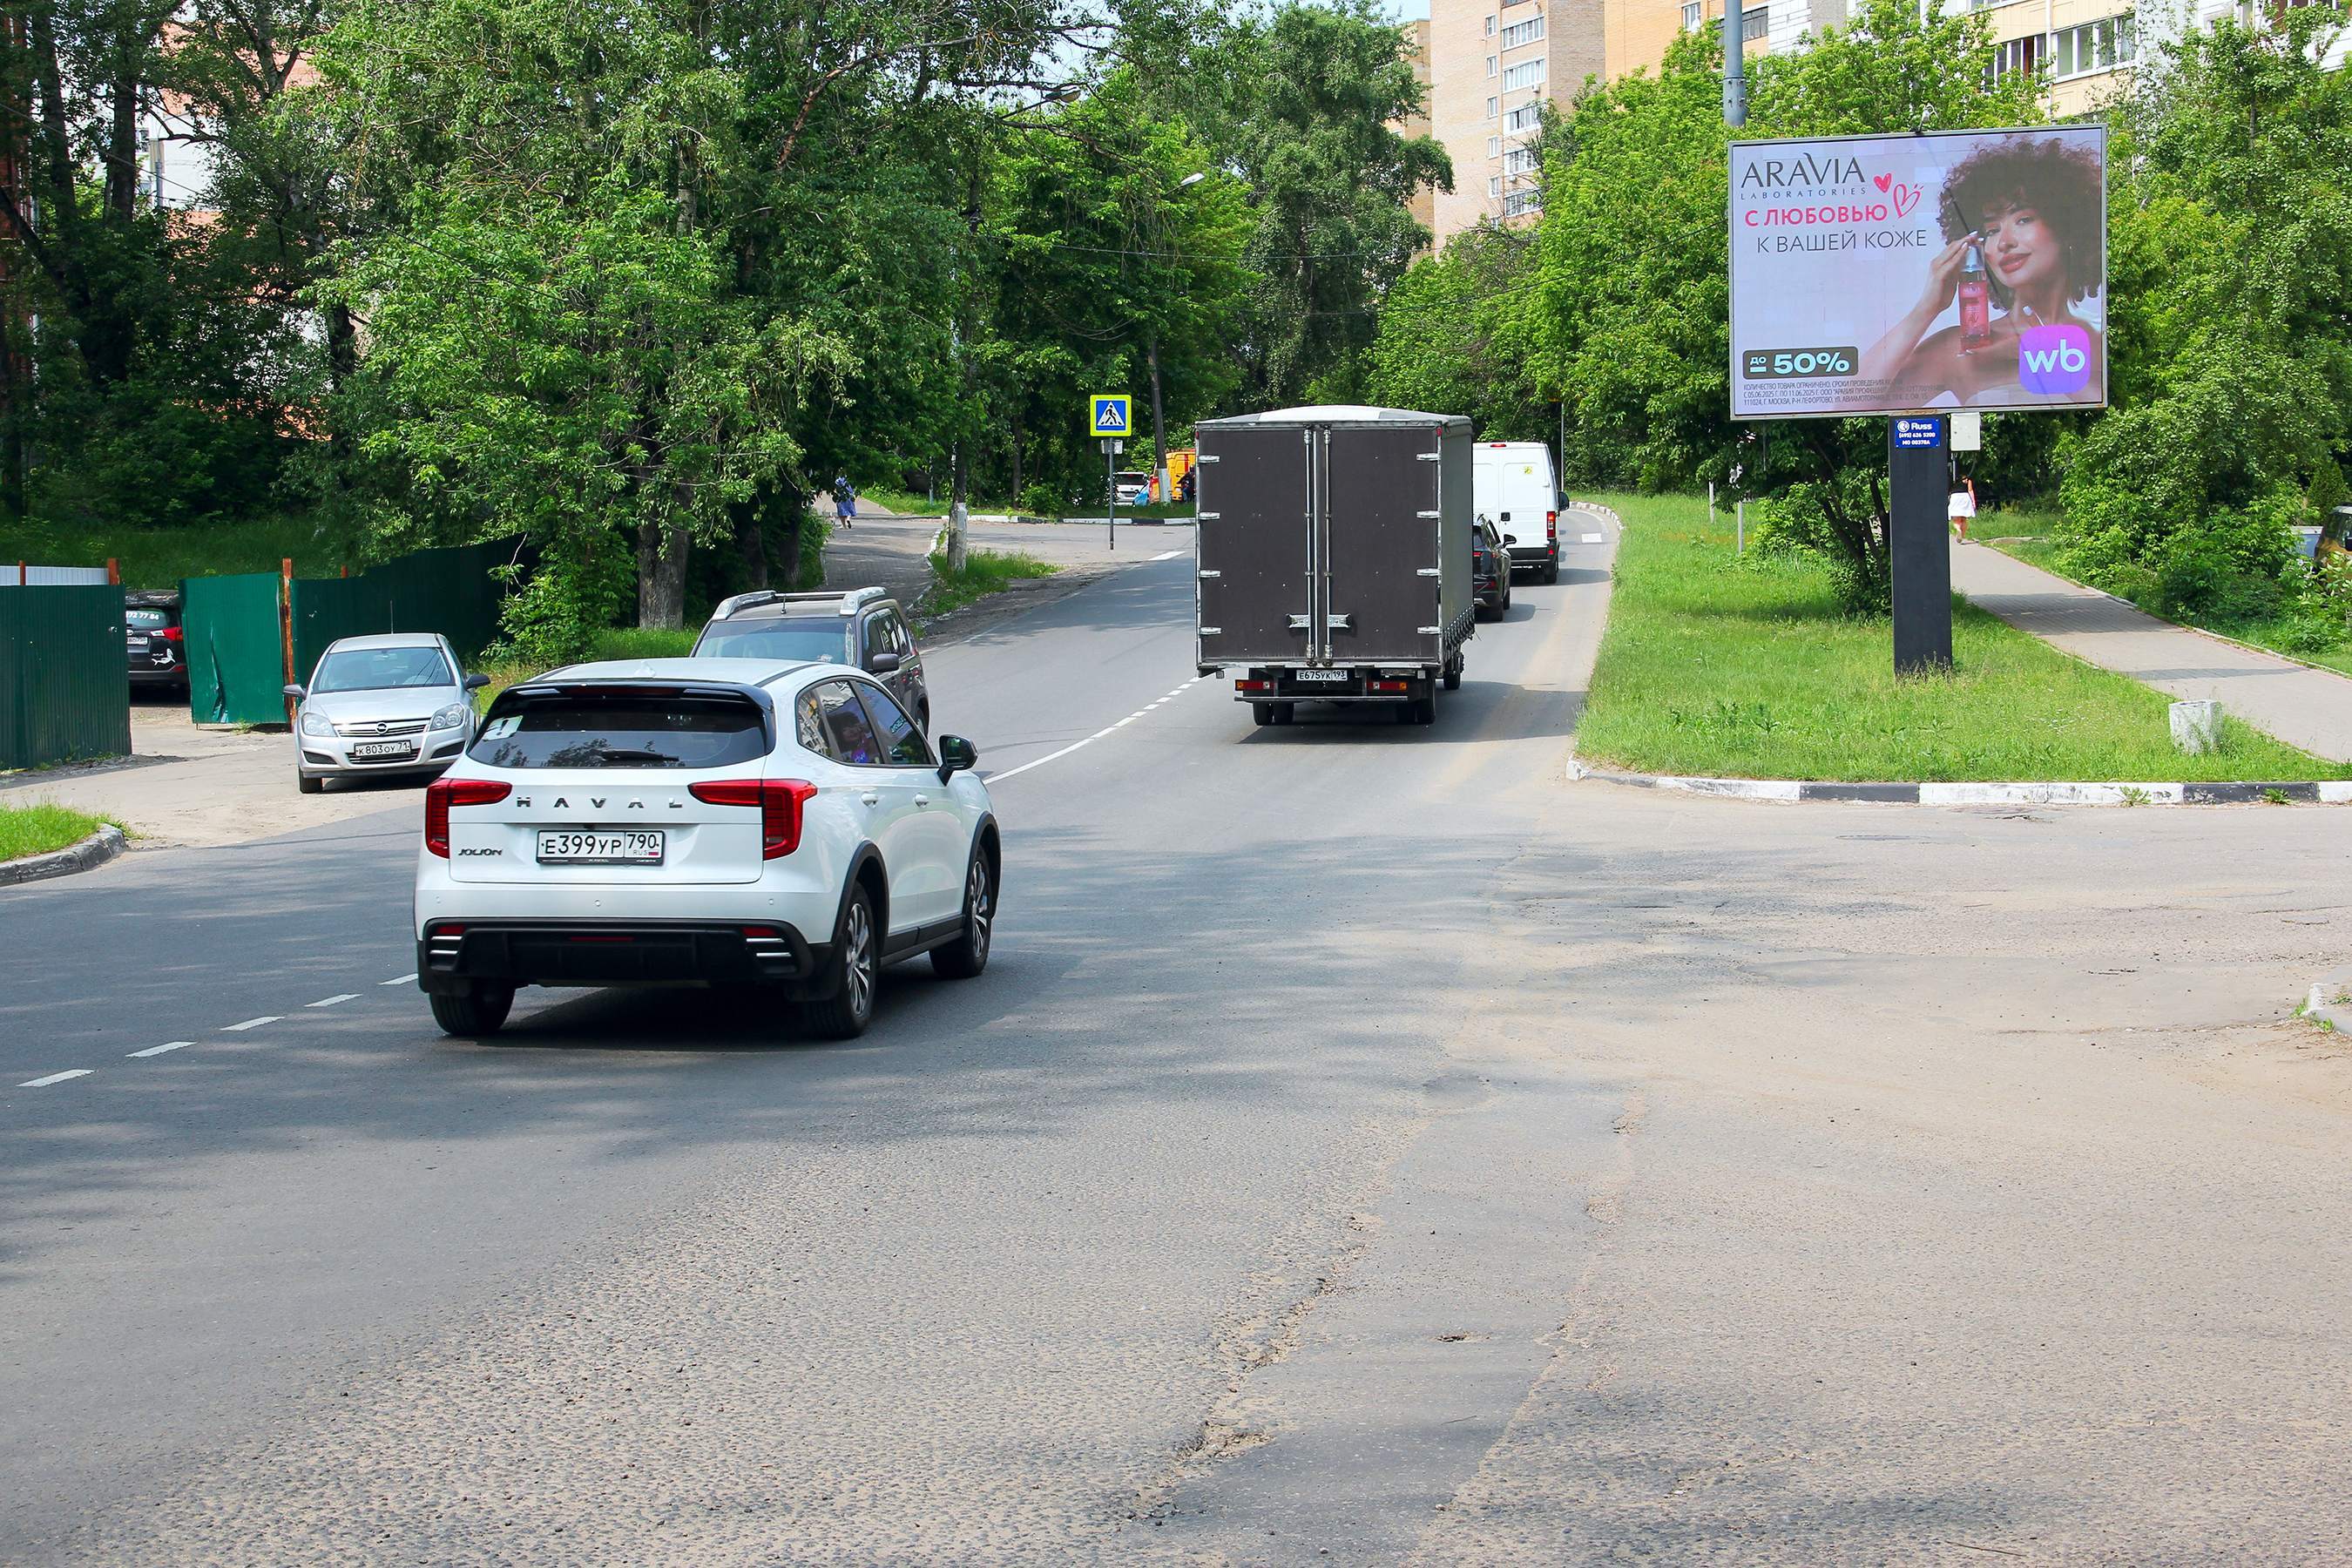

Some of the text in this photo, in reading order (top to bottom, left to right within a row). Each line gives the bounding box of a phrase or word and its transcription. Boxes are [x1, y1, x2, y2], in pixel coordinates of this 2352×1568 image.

[1740, 152, 1865, 188] ARAVIA
[1740, 186, 1866, 200] LABORATORIES
[1745, 205, 1888, 226] С ЛЮБОВЬЮ
[1757, 229, 1926, 253] К ВАШЕЙ КОЖЕ
[1774, 352, 1849, 375] 50%
[2024, 338, 2085, 373] wb
[397, 742, 408, 751] 71
[517, 796, 683, 808] HAVAL
[627, 834, 657, 849] 790
